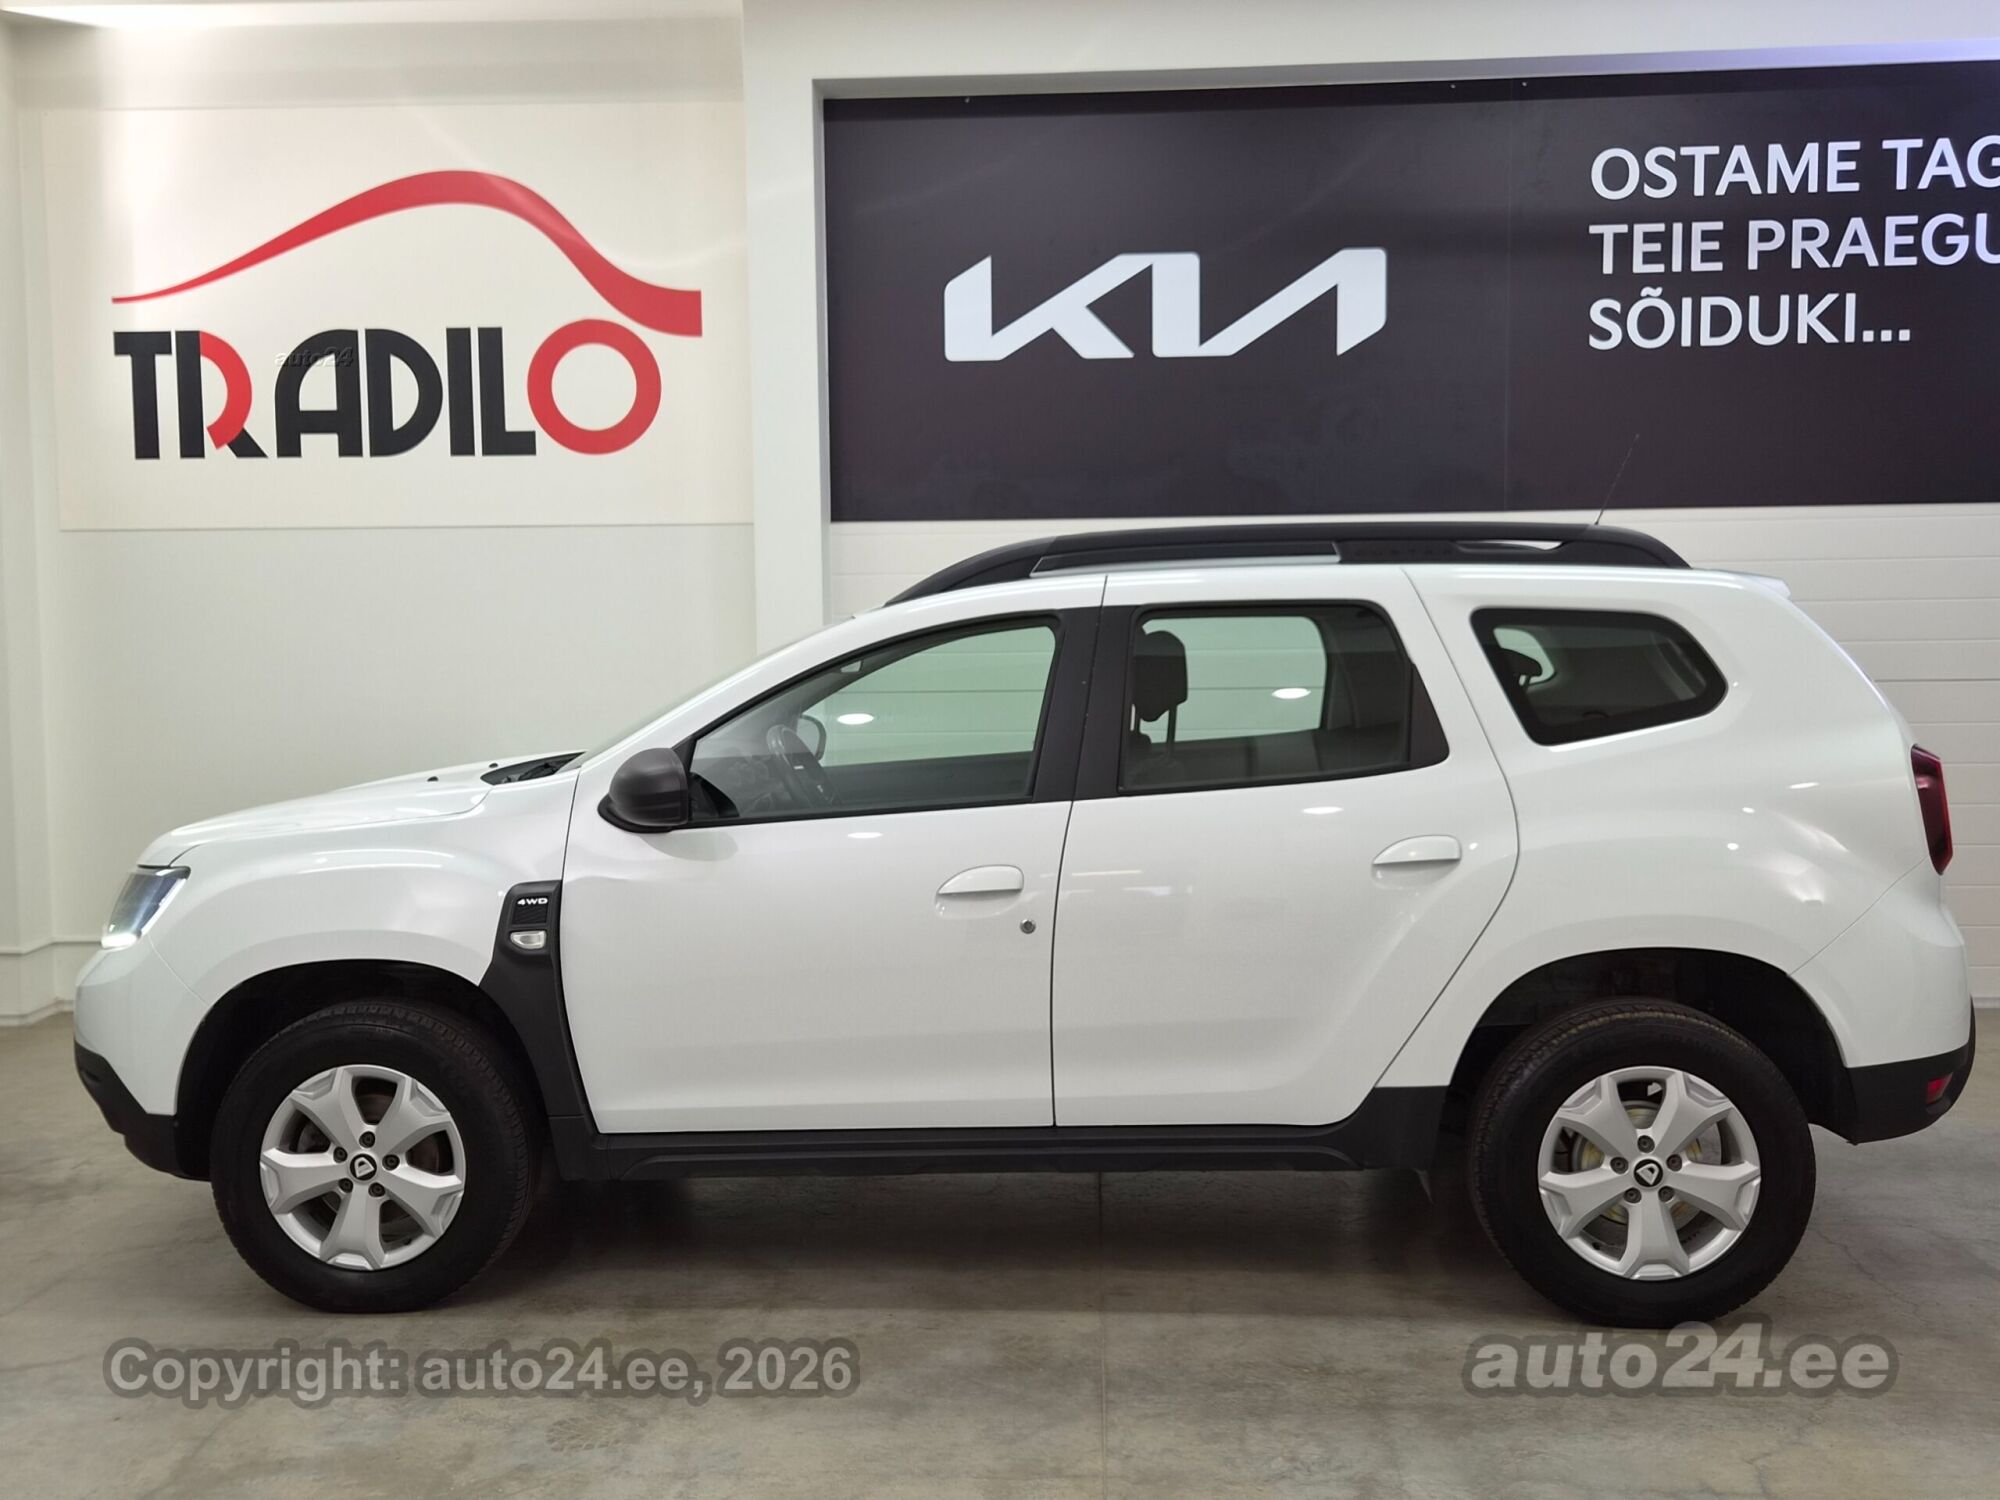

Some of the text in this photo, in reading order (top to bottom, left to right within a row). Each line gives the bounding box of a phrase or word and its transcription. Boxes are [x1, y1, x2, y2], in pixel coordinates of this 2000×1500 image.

[1590, 134, 2000, 200] OSTAME TAG
[1588, 212, 2000, 275] TEIE PRAEGU
[1588, 286, 1911, 350] SÕIDUKI...
[113, 318, 663, 460] TRADILO
[517, 897, 549, 906] 4WD
